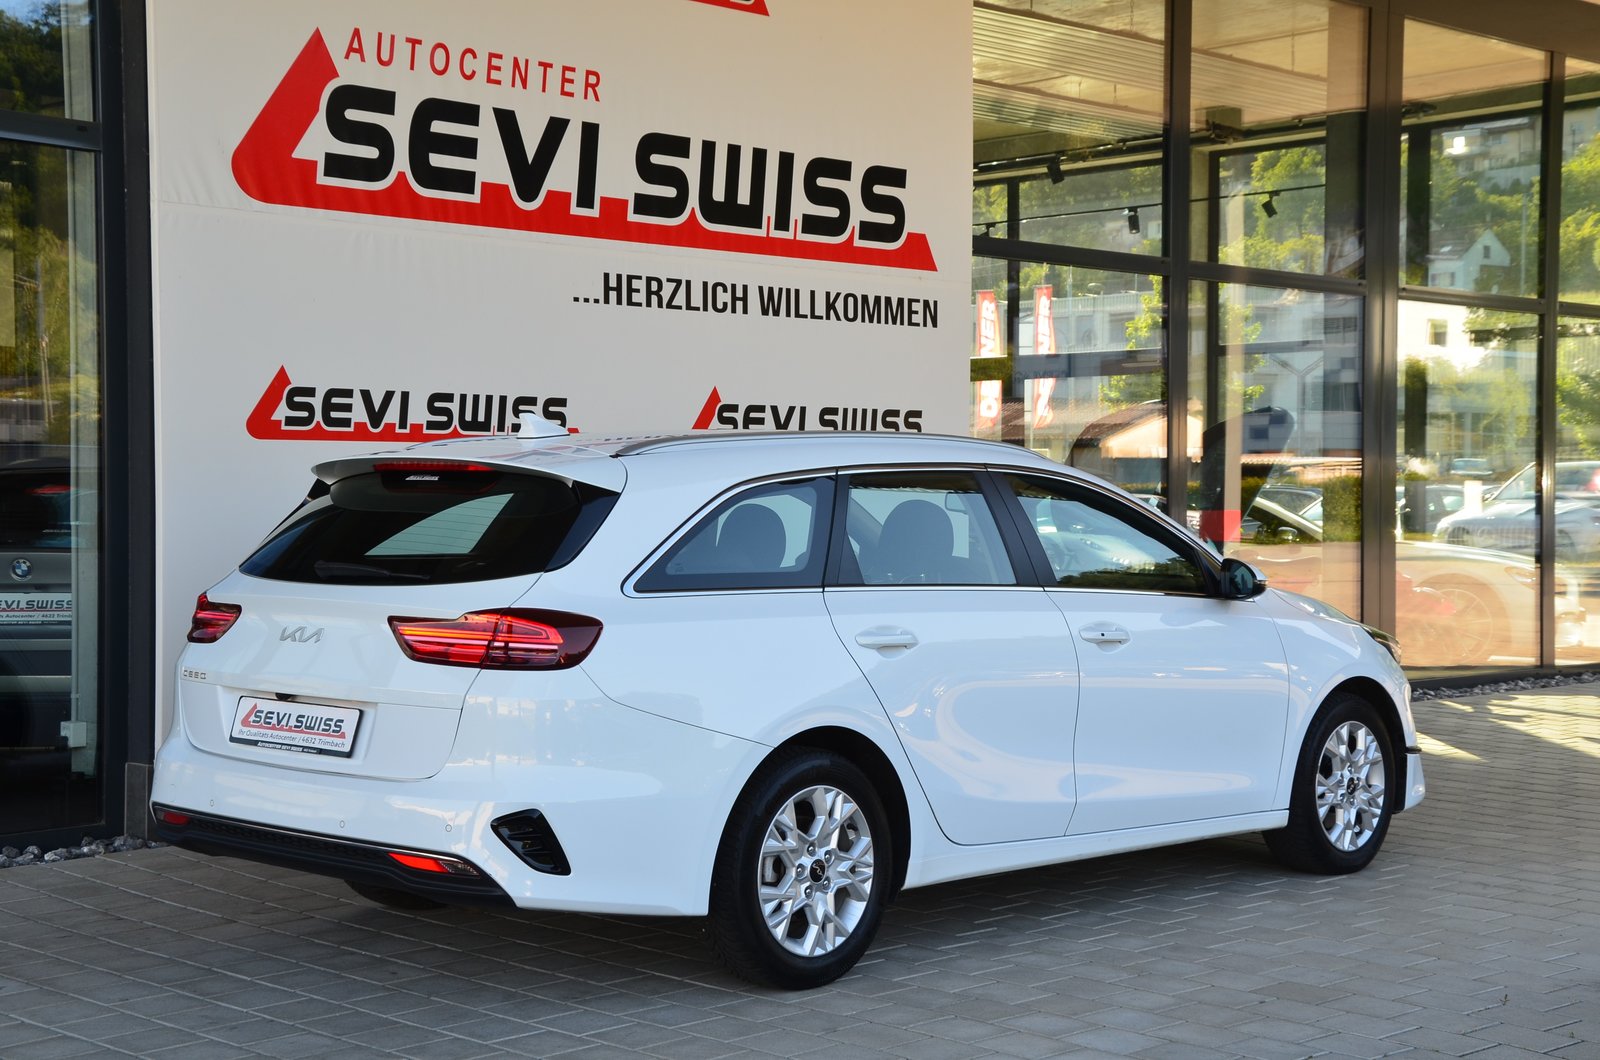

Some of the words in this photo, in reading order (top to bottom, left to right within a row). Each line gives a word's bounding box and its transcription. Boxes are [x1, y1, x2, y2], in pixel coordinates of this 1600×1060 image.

[344, 27, 601, 102] AUTOCENTER
[323, 84, 600, 210] SEVI
[632, 132, 908, 245] SWISS
[573, 272, 749, 315] ...HERZLICH
[757, 285, 938, 328] WILLKOMMEN
[284, 386, 410, 430] SEVI
[425, 392, 567, 433] SWISS
[717, 404, 806, 431] SEVI
[280, 626, 325, 643] KIA
[251, 710, 292, 726] SEVI
[294, 714, 345, 734] SWISS
[270, 732, 297, 743] Autocenter
[301, 737, 317, 745] 4632
[318, 738, 346, 749] Trimbach
